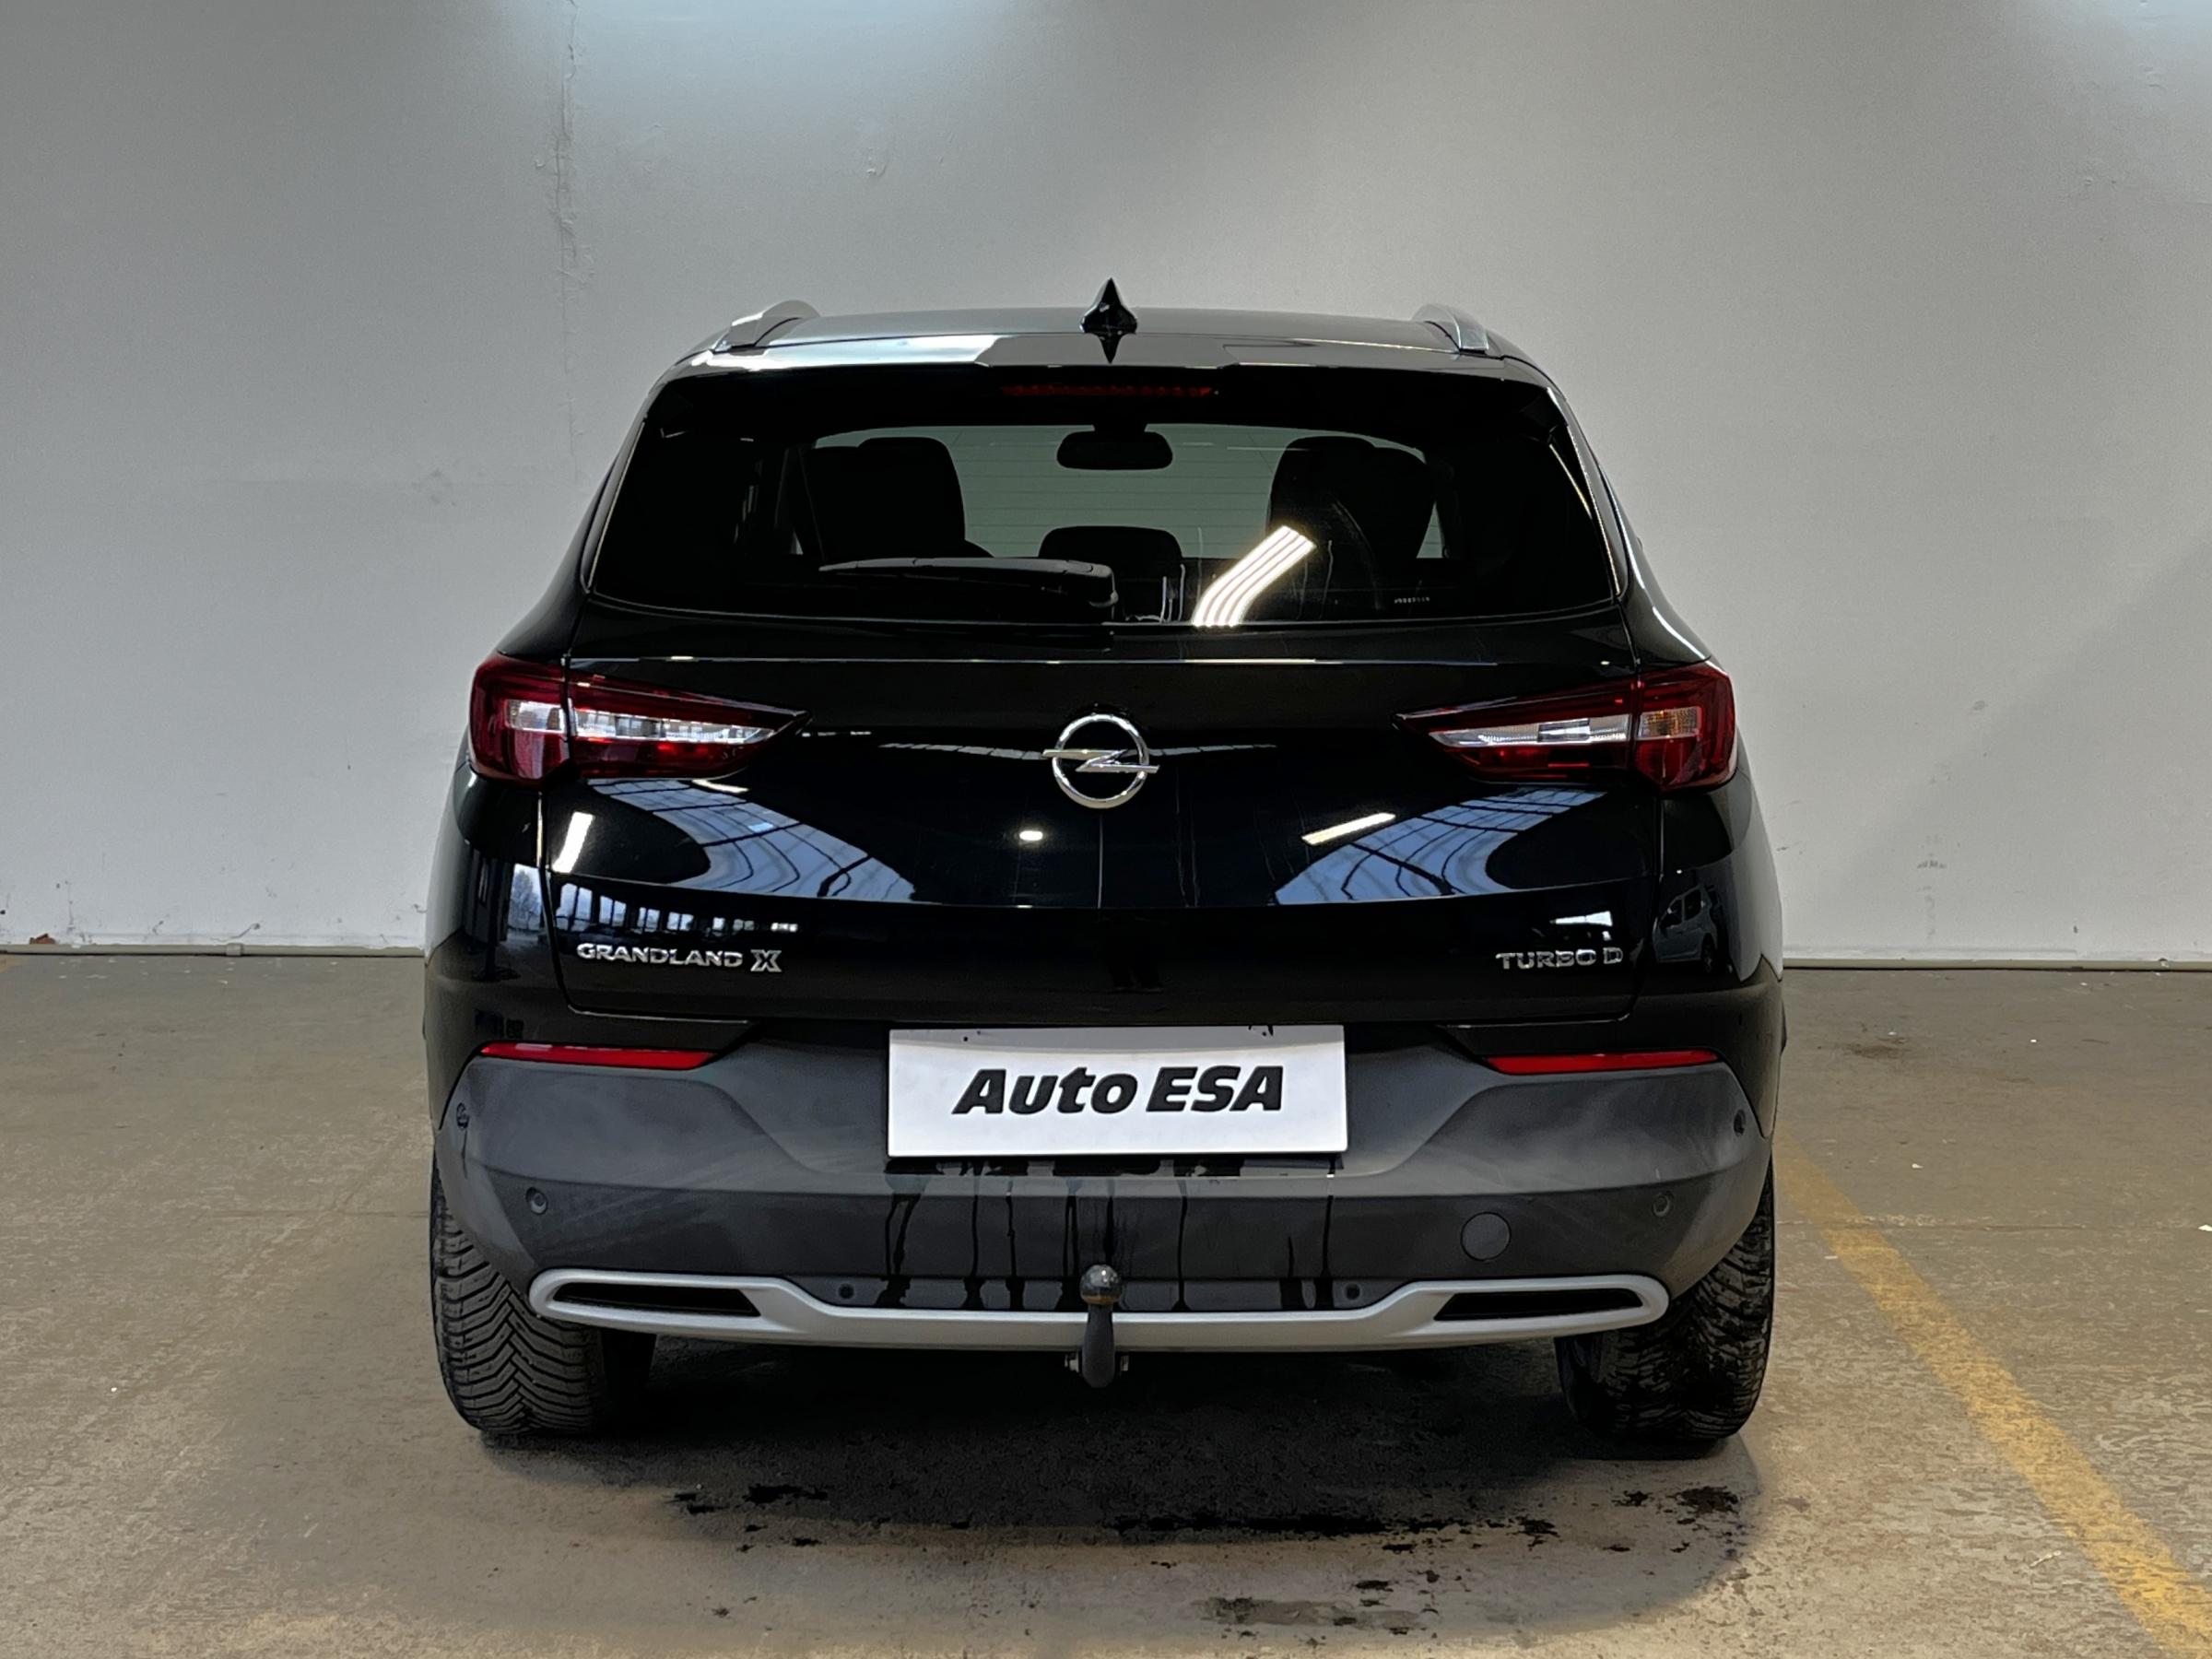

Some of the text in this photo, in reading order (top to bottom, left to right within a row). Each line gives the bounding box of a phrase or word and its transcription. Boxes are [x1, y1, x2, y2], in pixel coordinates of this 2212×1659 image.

[576, 942, 782, 972] GRANDLAND X
[1495, 947, 1623, 970] TURBO D
[951, 1065, 1283, 1114] Auto ESA
